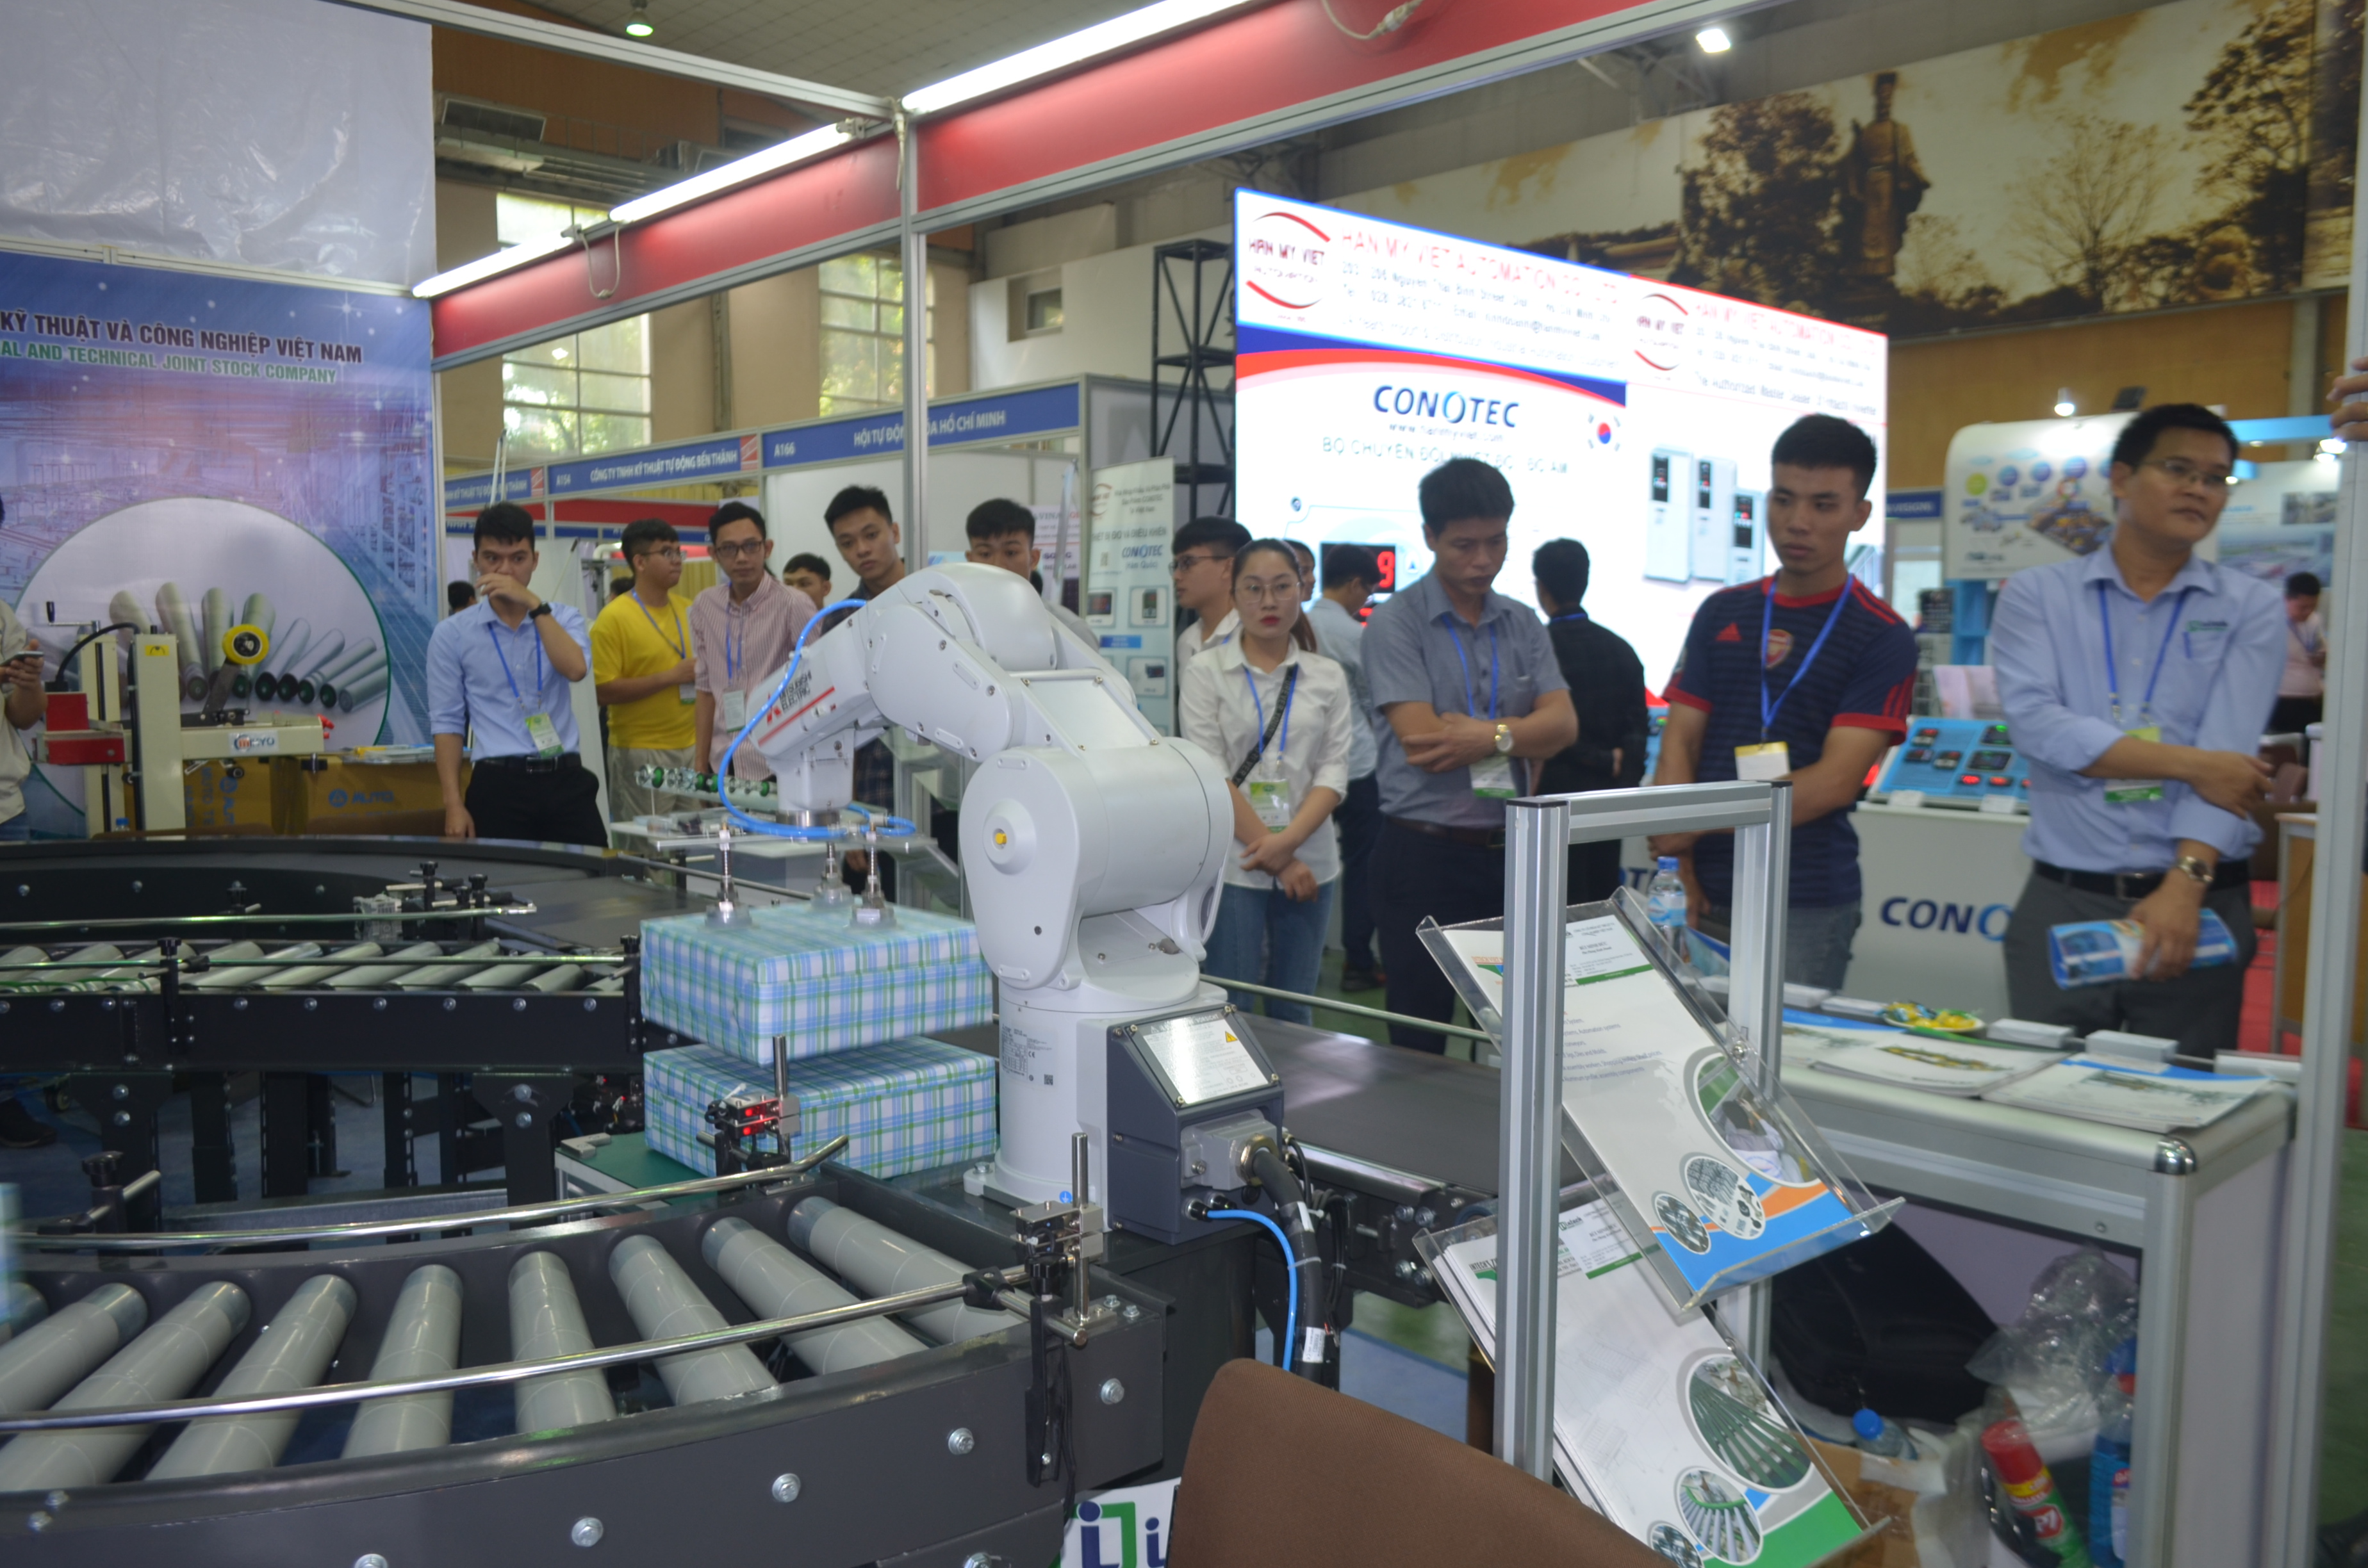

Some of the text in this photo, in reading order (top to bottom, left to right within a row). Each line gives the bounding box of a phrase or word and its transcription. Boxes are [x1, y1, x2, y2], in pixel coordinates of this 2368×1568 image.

[1, 309, 362, 363] KỸ THUẬT VÀ CÔNG NGHIỆP VIỆT NAM
[28, 343, 62, 361] AND
[67, 347, 158, 369] TECHNICAL
[163, 355, 207, 372] JOINT
[212, 359, 259, 377] STOCK
[265, 364, 336, 384] COMPANY
[1373, 384, 1520, 429] CONOTEC
[773, 443, 796, 457] A166
[957, 411, 975, 431] CHÍ
[975, 410, 1006, 429] MINH
[590, 466, 608, 483] CÔNG
